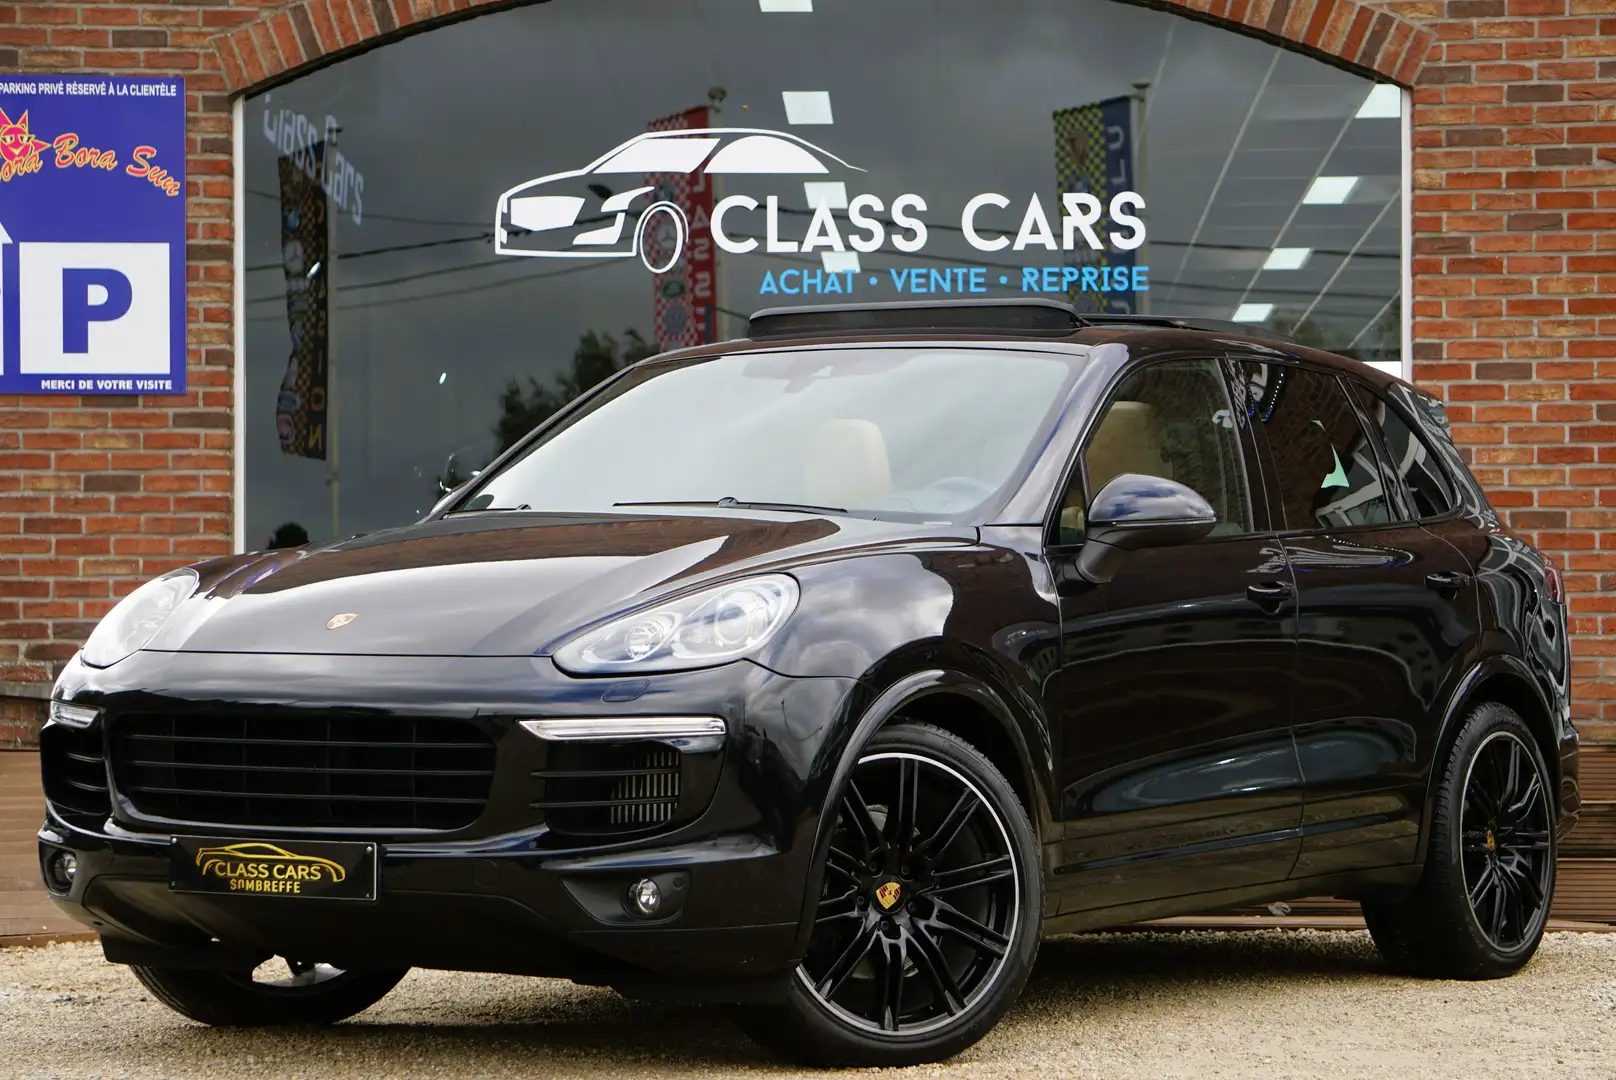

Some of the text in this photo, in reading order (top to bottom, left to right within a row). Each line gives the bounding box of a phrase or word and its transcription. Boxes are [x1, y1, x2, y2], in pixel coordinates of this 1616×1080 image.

[0, 81, 176, 96] PARKING PRIVÉ RÉSERVÉ À LA CLIENTÈLE
[0, 132, 181, 196] ora Bora Sun
[264, 94, 364, 226] Class Cars
[710, 191, 1146, 254] CLASS CARS
[760, 266, 1149, 294] ACHAT VENTE REPRISE
[62, 267, 133, 354] P
[41, 379, 173, 390] MERCI DE VOTRE VISITE
[214, 861, 322, 880] CLASS CARS
[229, 878, 301, 894] SOMBREFFE
